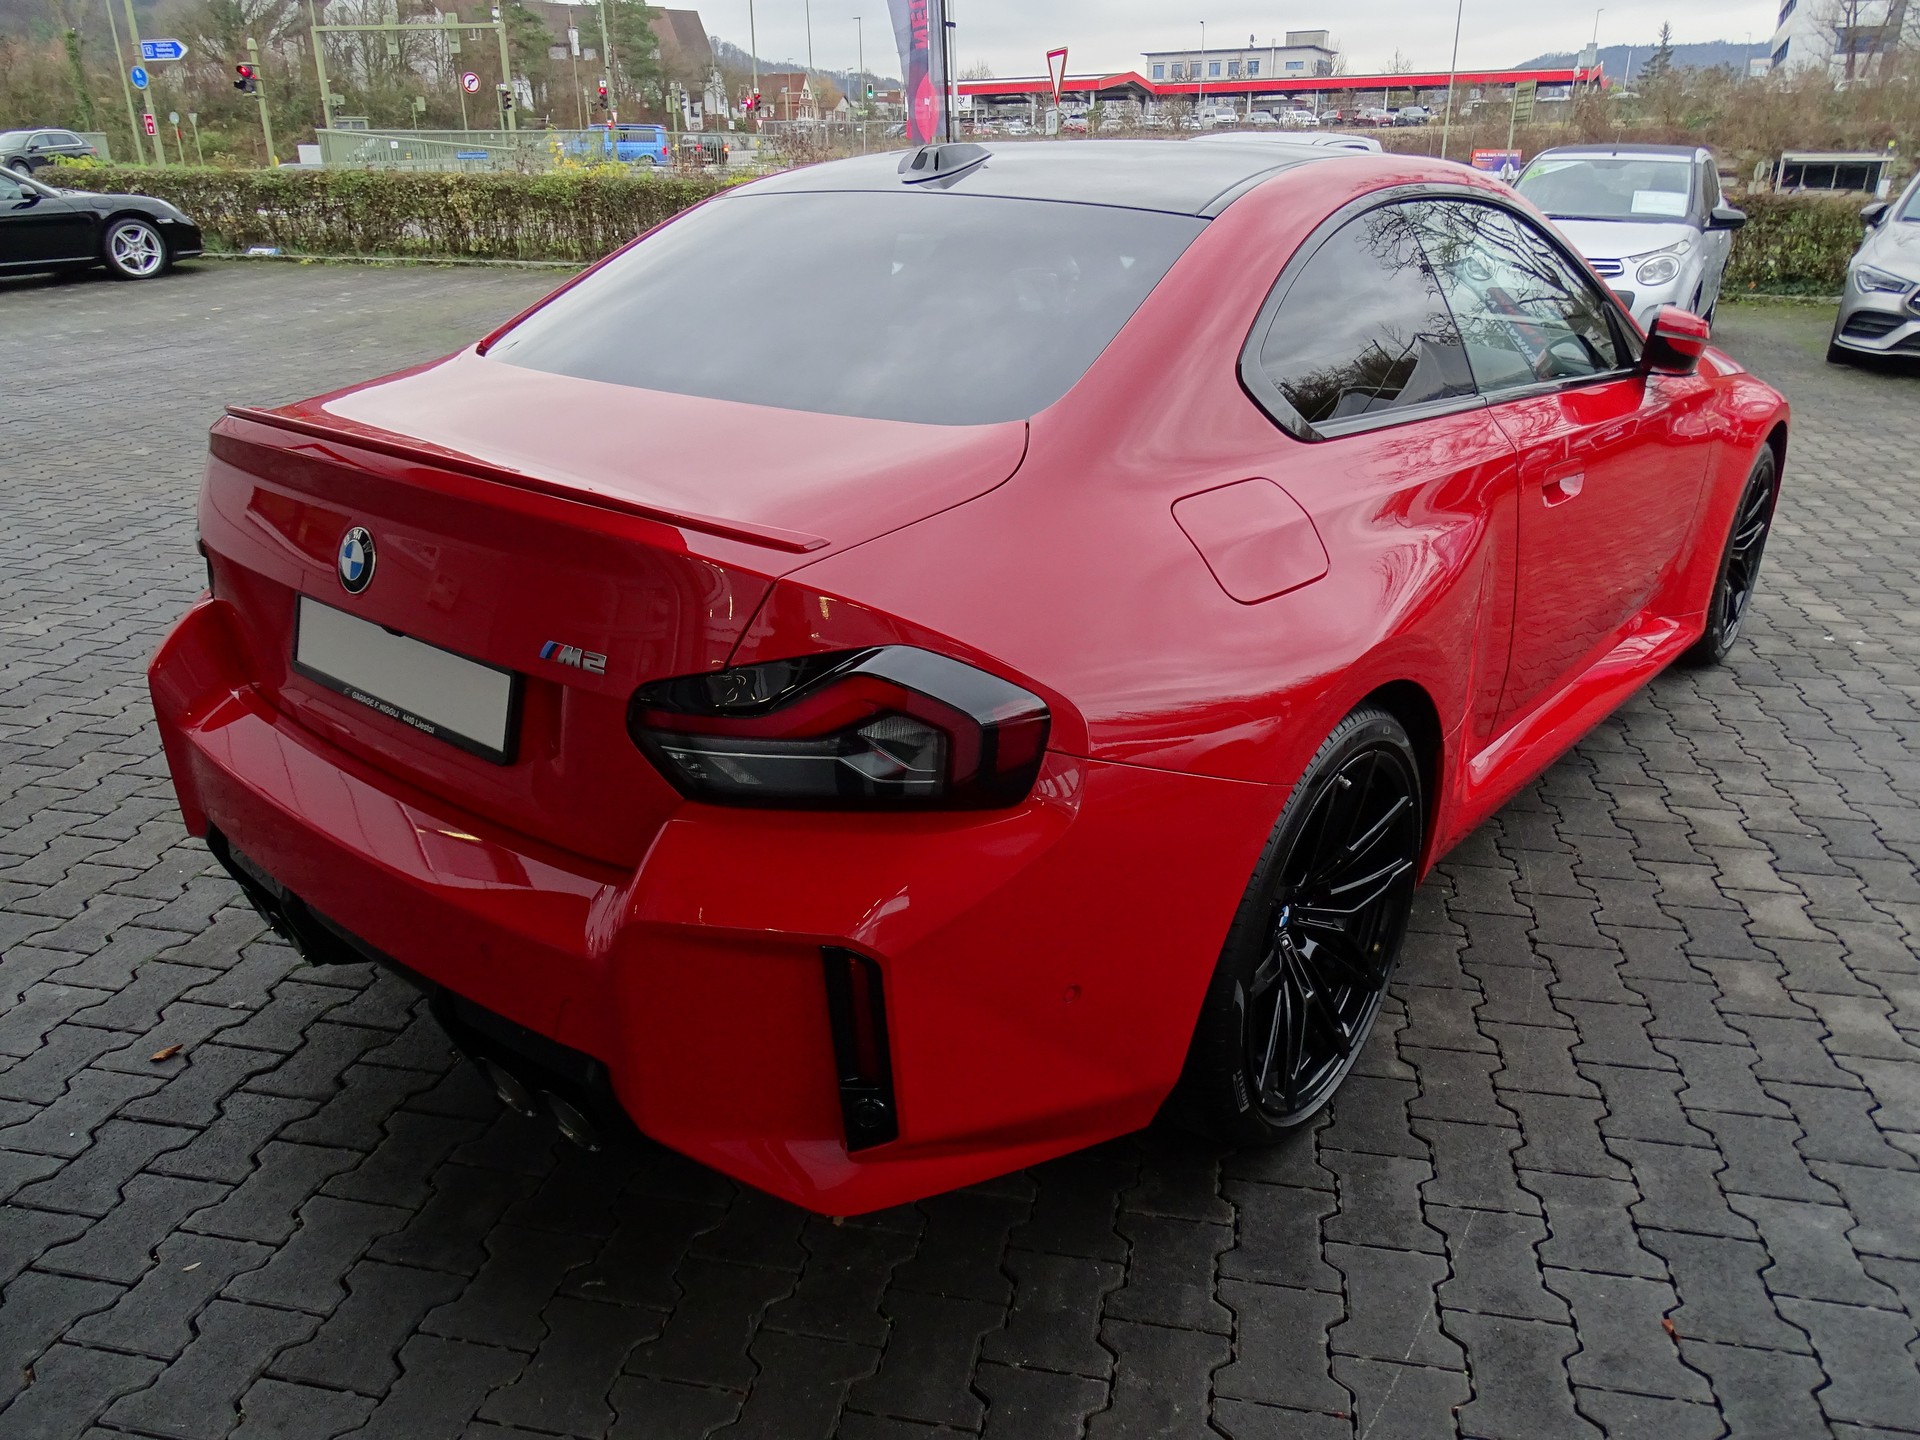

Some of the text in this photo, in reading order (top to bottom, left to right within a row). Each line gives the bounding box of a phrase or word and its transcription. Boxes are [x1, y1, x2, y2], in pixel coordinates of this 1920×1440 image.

[343, 529, 373, 553] BMW
[556, 644, 608, 676] M2
[351, 691, 375, 707] GARAGE
[415, 719, 435, 734] Liestal
